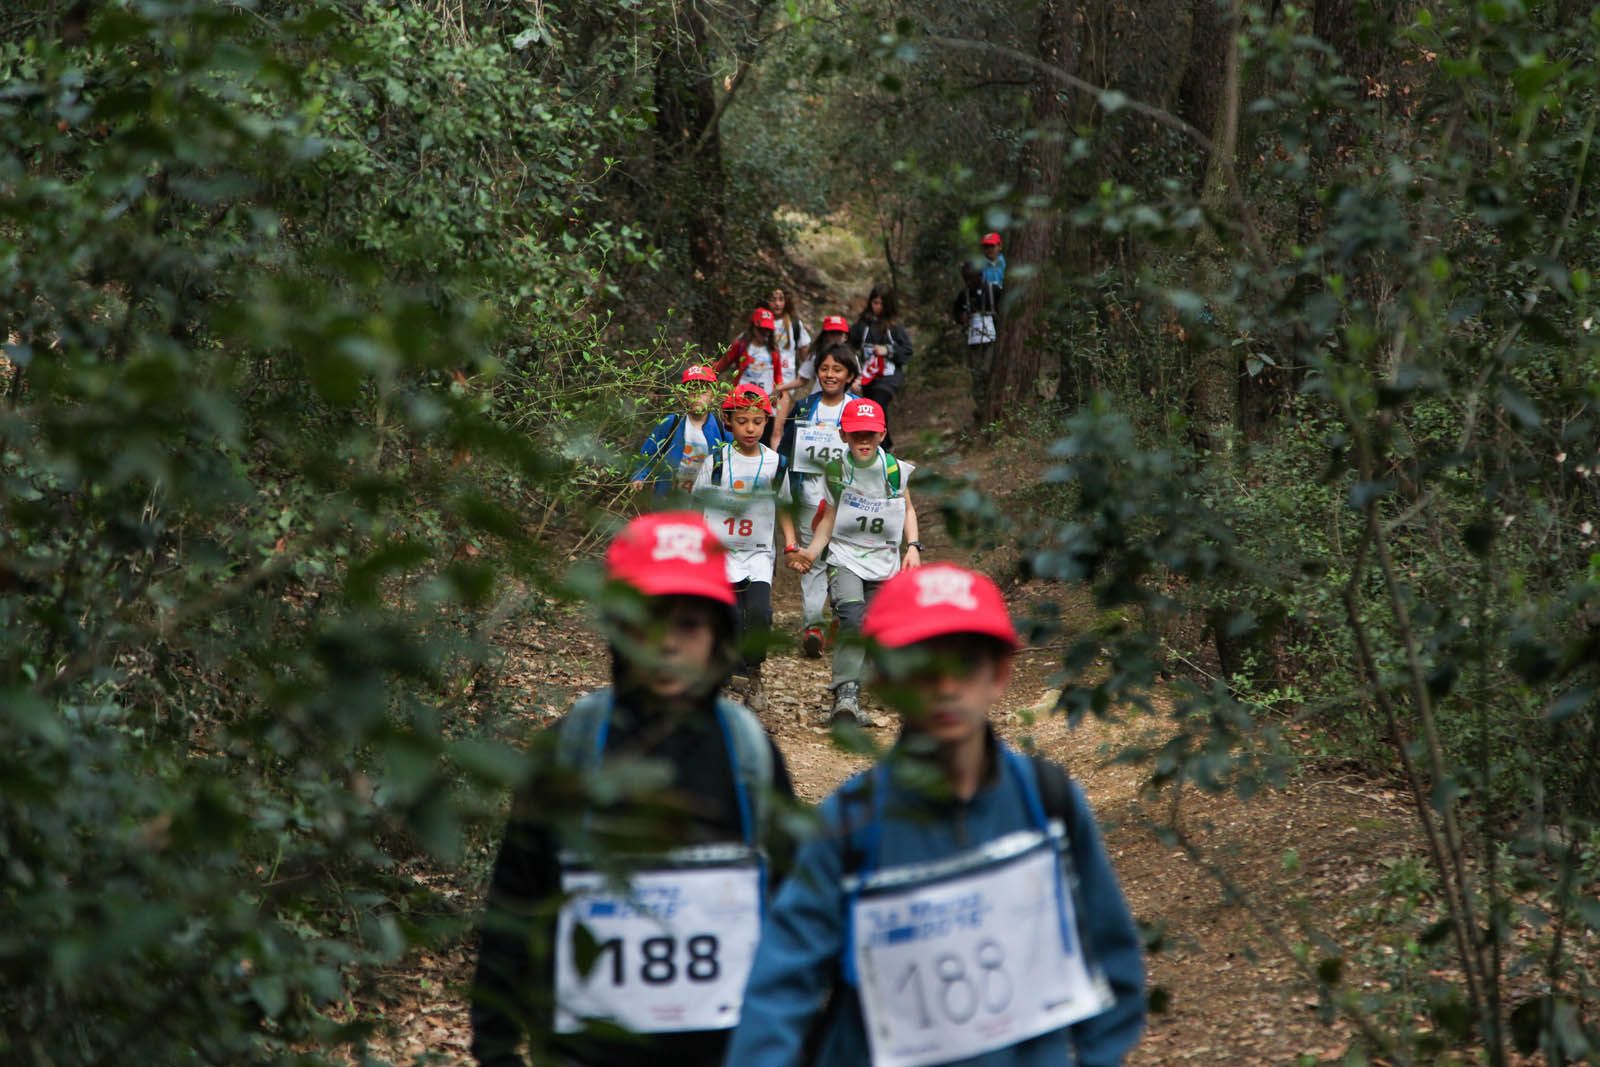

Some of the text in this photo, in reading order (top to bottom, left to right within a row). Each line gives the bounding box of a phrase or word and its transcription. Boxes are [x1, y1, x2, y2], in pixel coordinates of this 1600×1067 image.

[805, 446, 844, 465] 143
[722, 517, 753, 536] 18
[856, 516, 884, 534] 18
[602, 934, 720, 987] 188
[898, 938, 1013, 1030] 188
